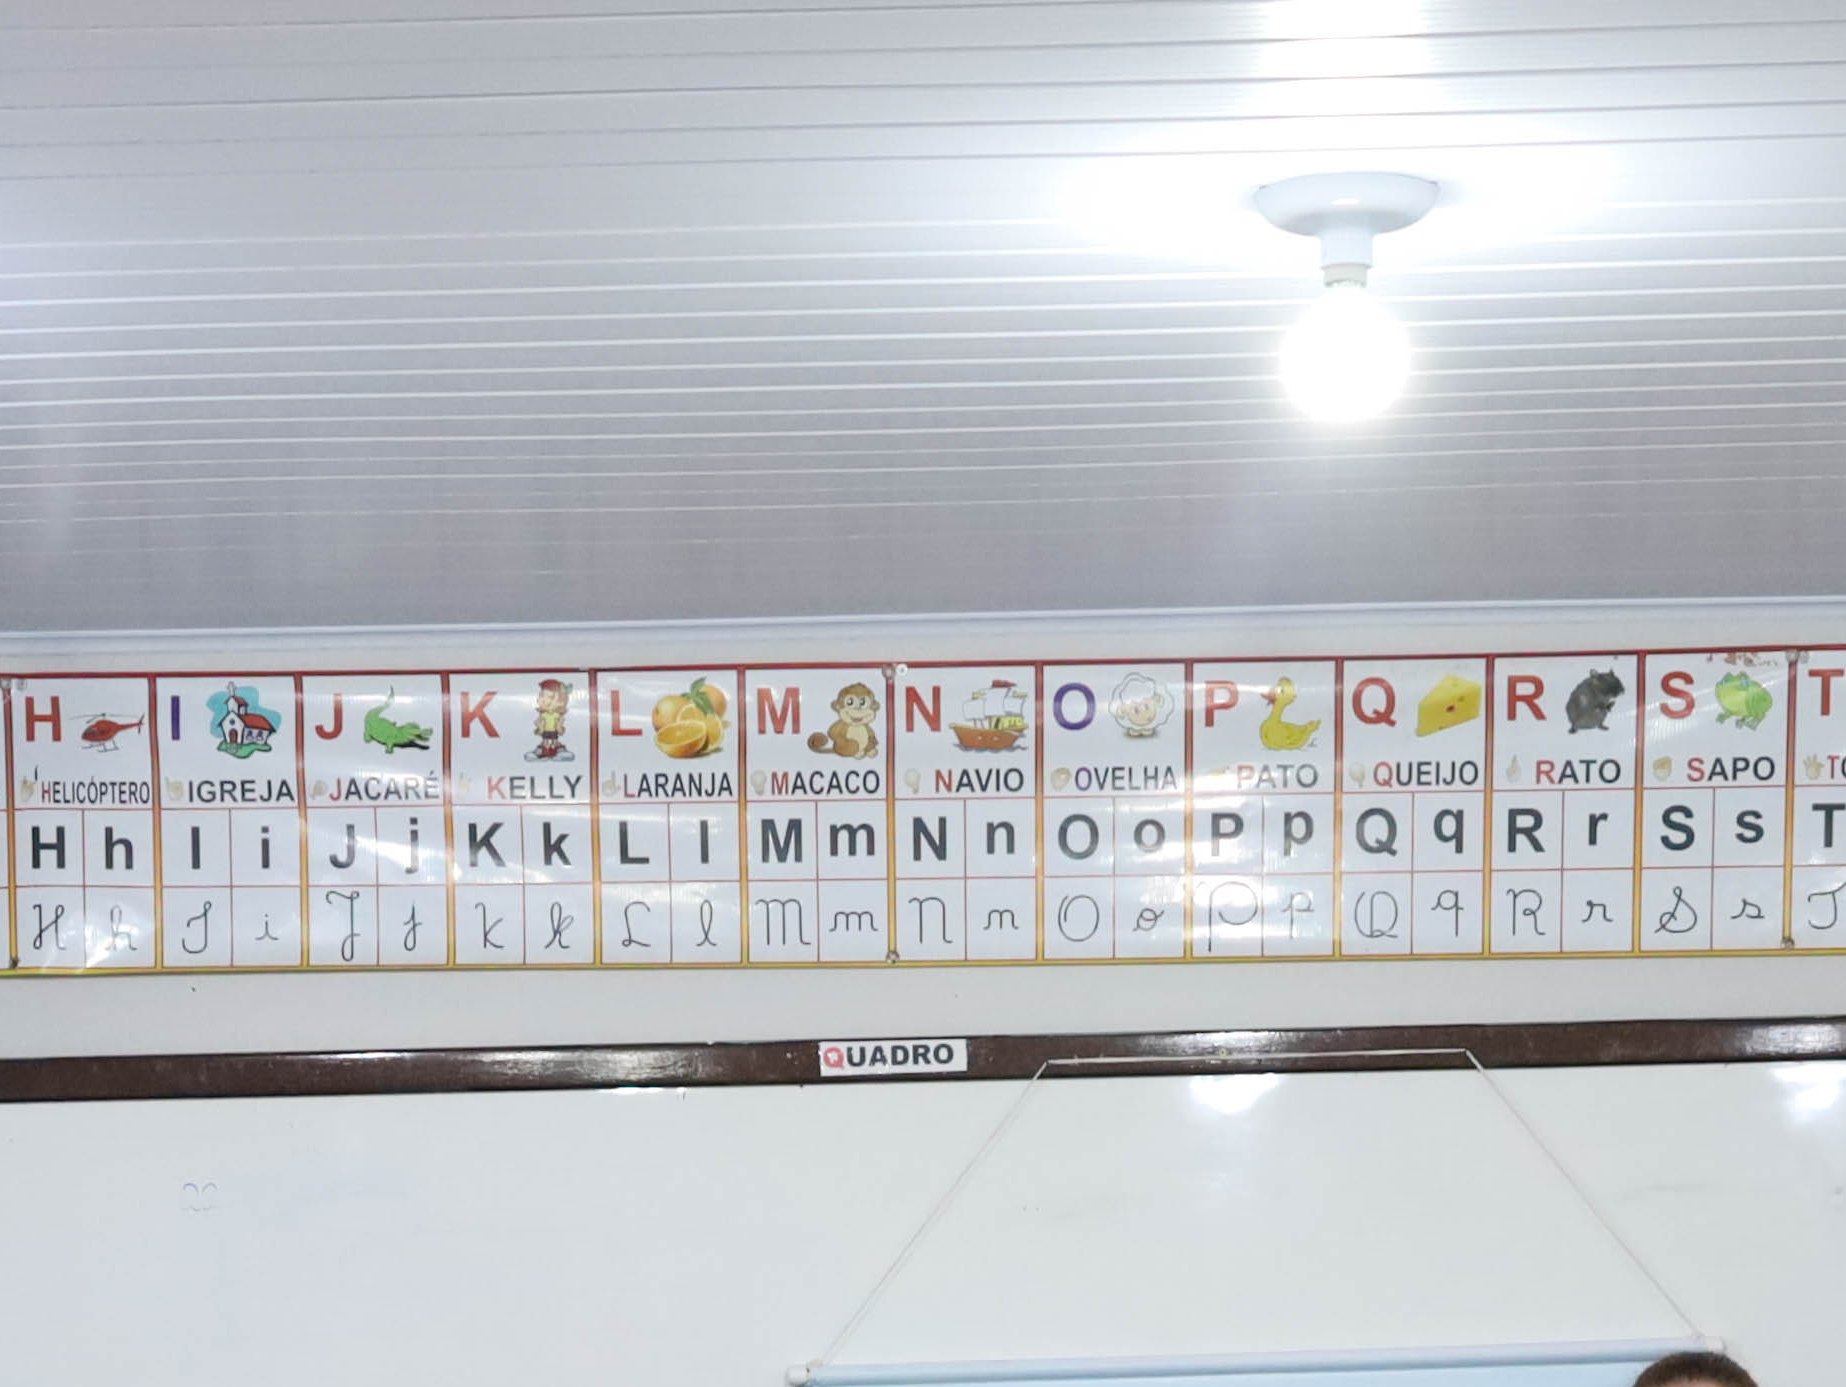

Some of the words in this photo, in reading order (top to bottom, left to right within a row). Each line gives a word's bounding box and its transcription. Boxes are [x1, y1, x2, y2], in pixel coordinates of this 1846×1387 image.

[770, 768, 881, 796] MACACO
[934, 766, 1024, 794] NAVIO
[1075, 764, 1178, 792] OVELHA
[1236, 761, 1318, 789] PATO
[1372, 757, 1479, 788] QUEIJO
[1536, 757, 1622, 785] RATO
[1687, 755, 1775, 783] SAPO
[41, 776, 150, 806] HELICÓPTERO
[186, 777, 295, 803] IGREJA
[328, 769, 440, 802] JACARÉ
[487, 772, 582, 801] KELLY
[623, 771, 734, 798] LARANJA
[823, 1043, 954, 1068] QUADRO
